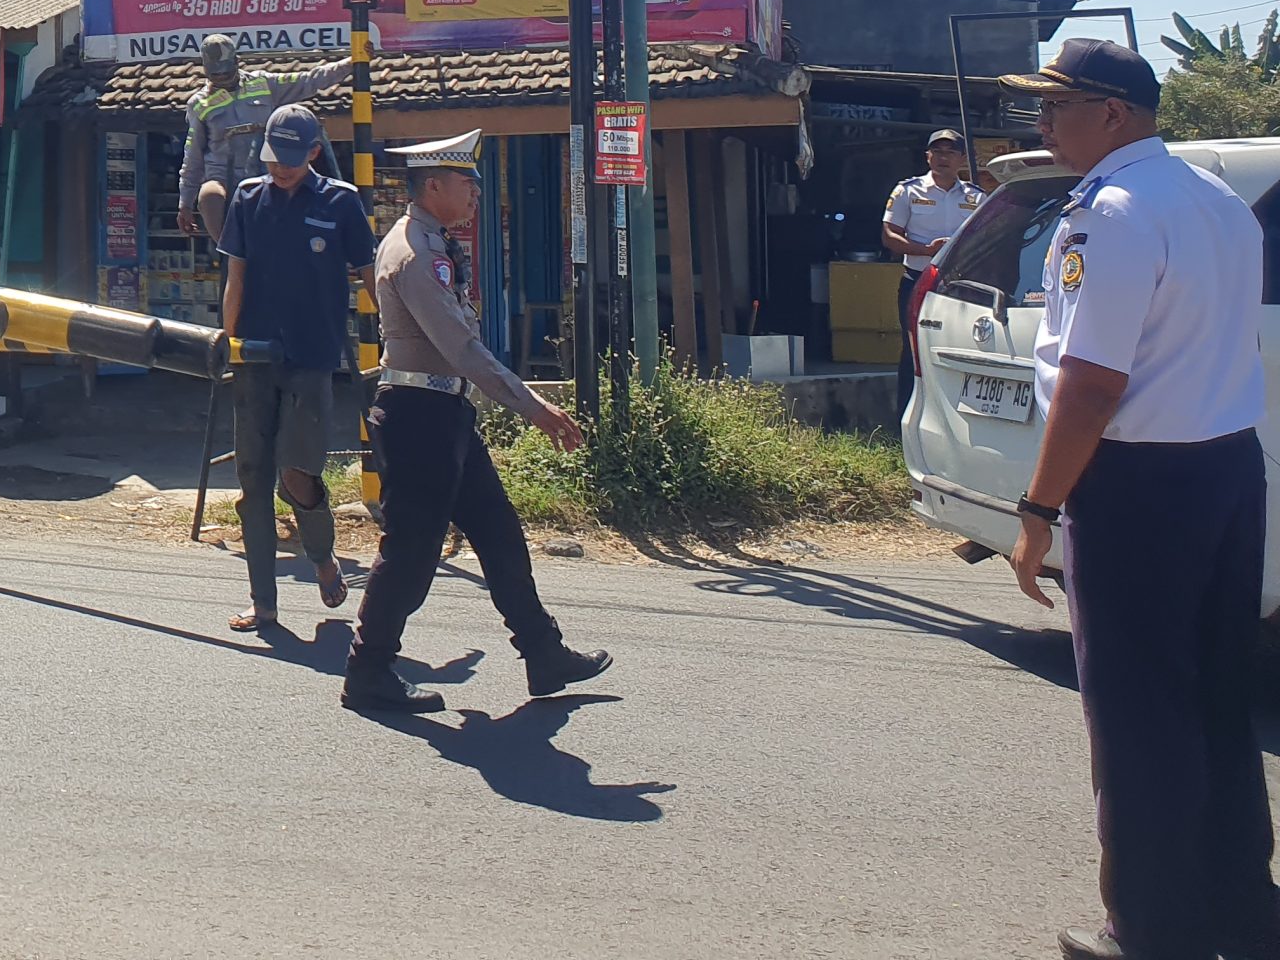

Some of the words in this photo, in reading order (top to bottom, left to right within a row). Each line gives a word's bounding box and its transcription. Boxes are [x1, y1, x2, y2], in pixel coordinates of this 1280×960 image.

[210, 0, 241, 16] RIBU
[130, 29, 293, 58] NUSAARA
[597, 106, 626, 115] PASANG
[627, 105, 644, 114] WIFI
[604, 116, 637, 127] GRATIS
[602, 132, 615, 142] 50
[616, 134, 633, 143] Mbps
[962, 373, 972, 397] K
[976, 376, 1004, 402] 1180
[1013, 383, 1030, 407] AG
